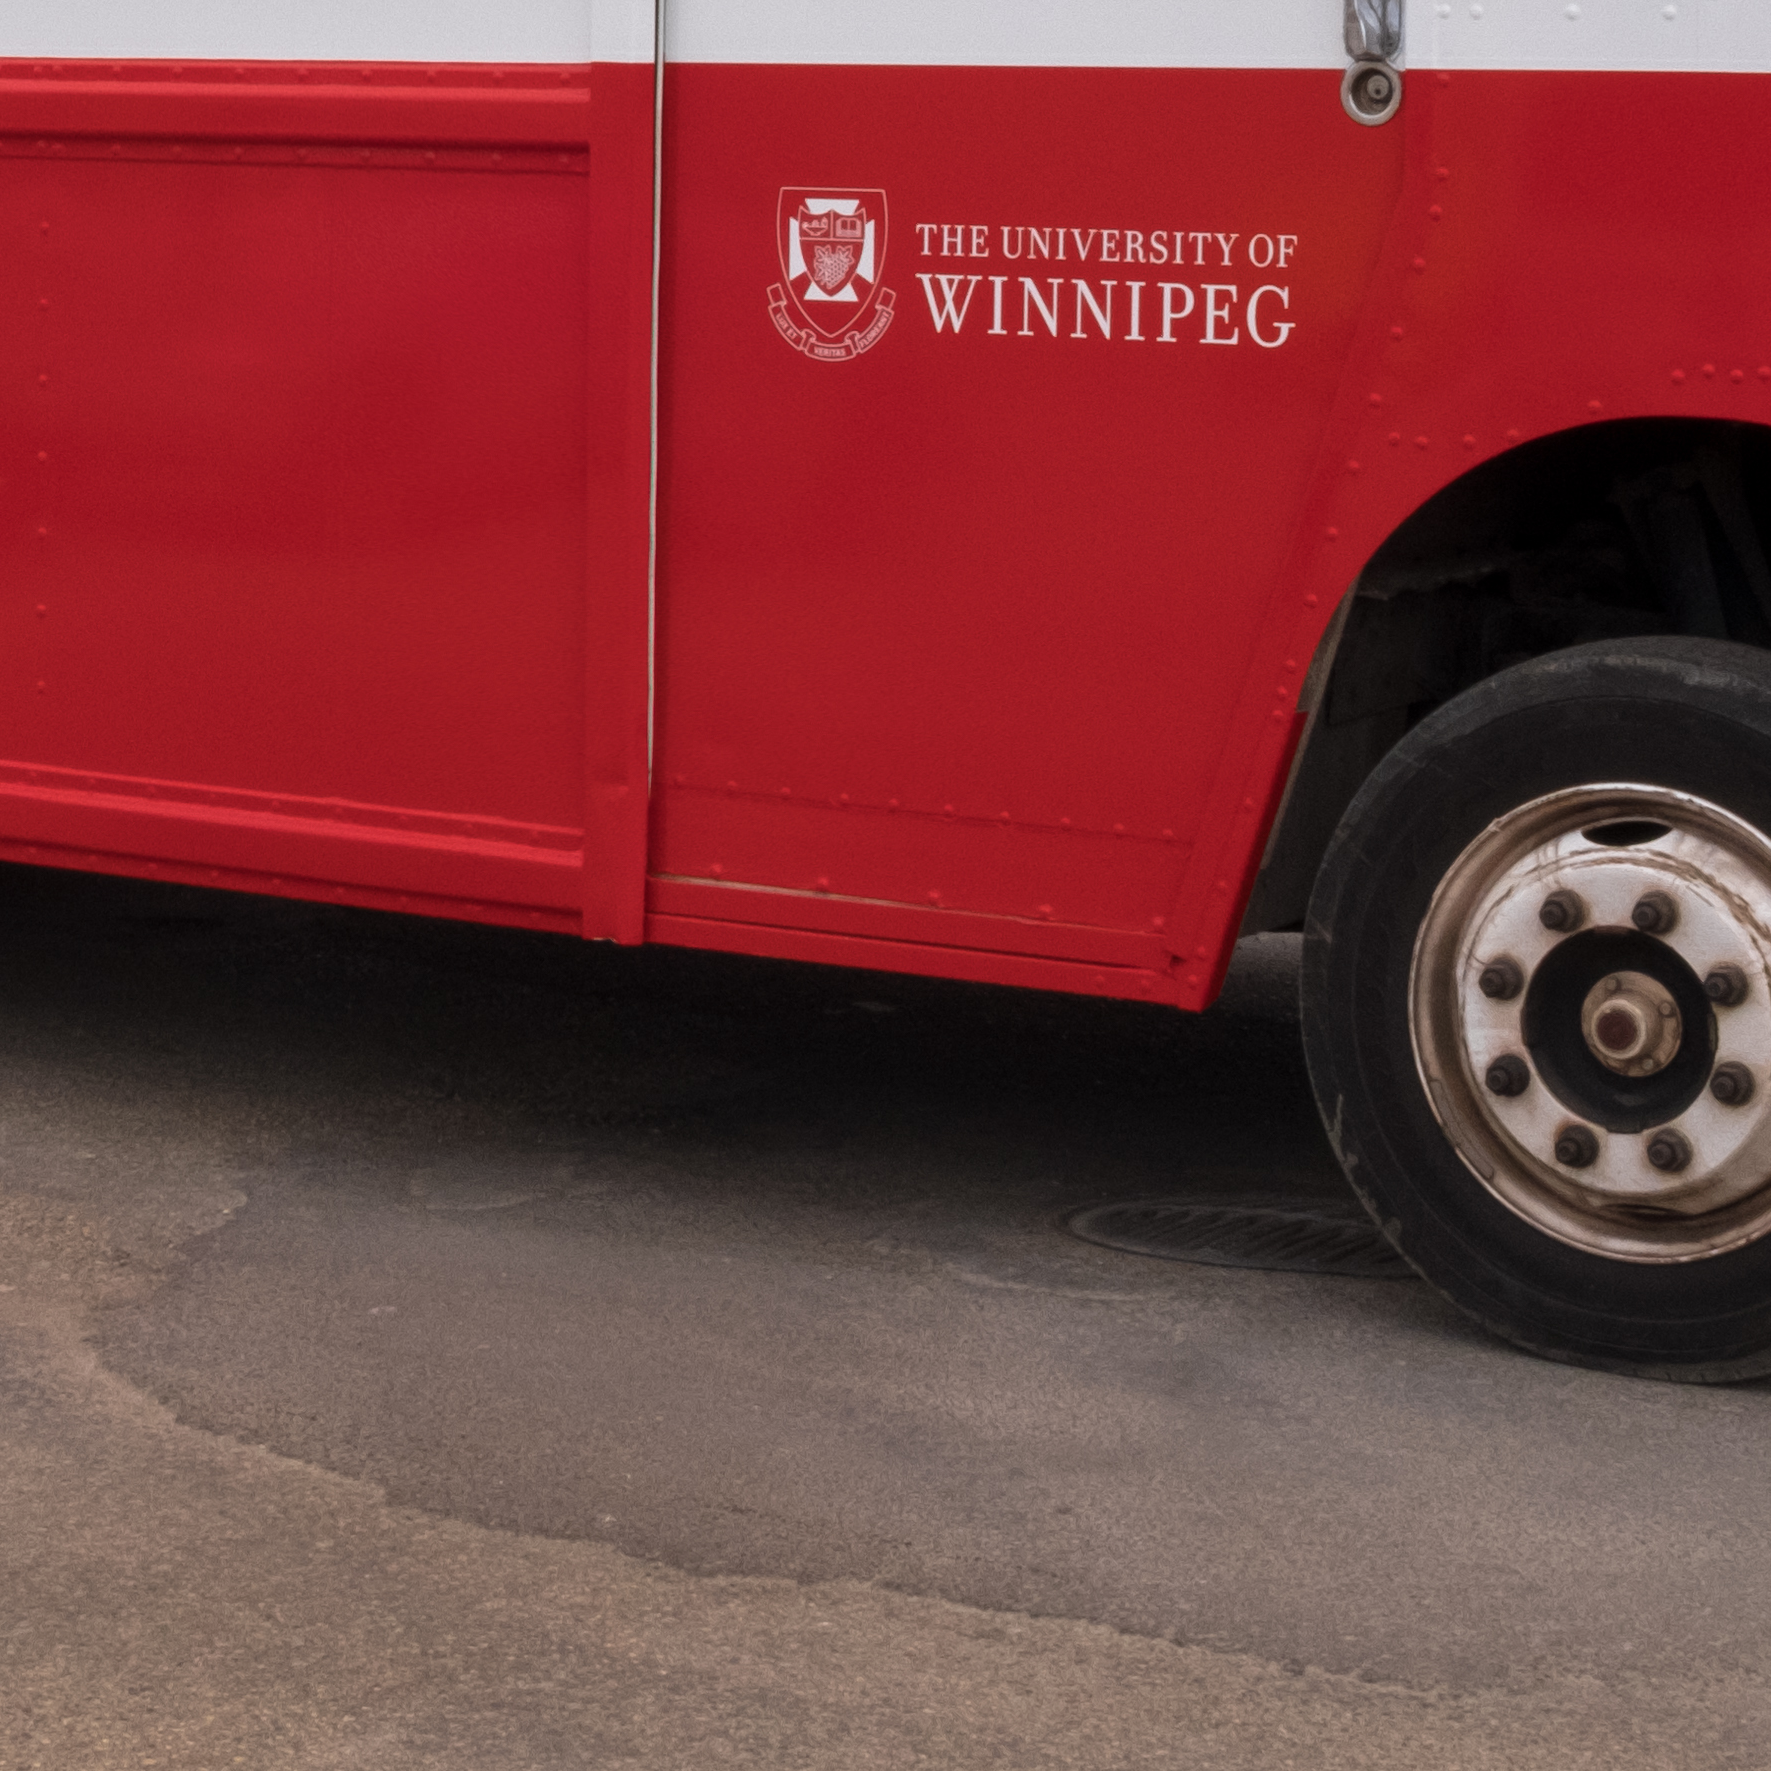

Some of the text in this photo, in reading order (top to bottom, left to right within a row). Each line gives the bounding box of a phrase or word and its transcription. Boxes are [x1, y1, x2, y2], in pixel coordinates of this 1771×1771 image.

[915, 223, 1298, 268] THE UNIVERSITY OF
[915, 273, 1296, 348] WINNIPEG
